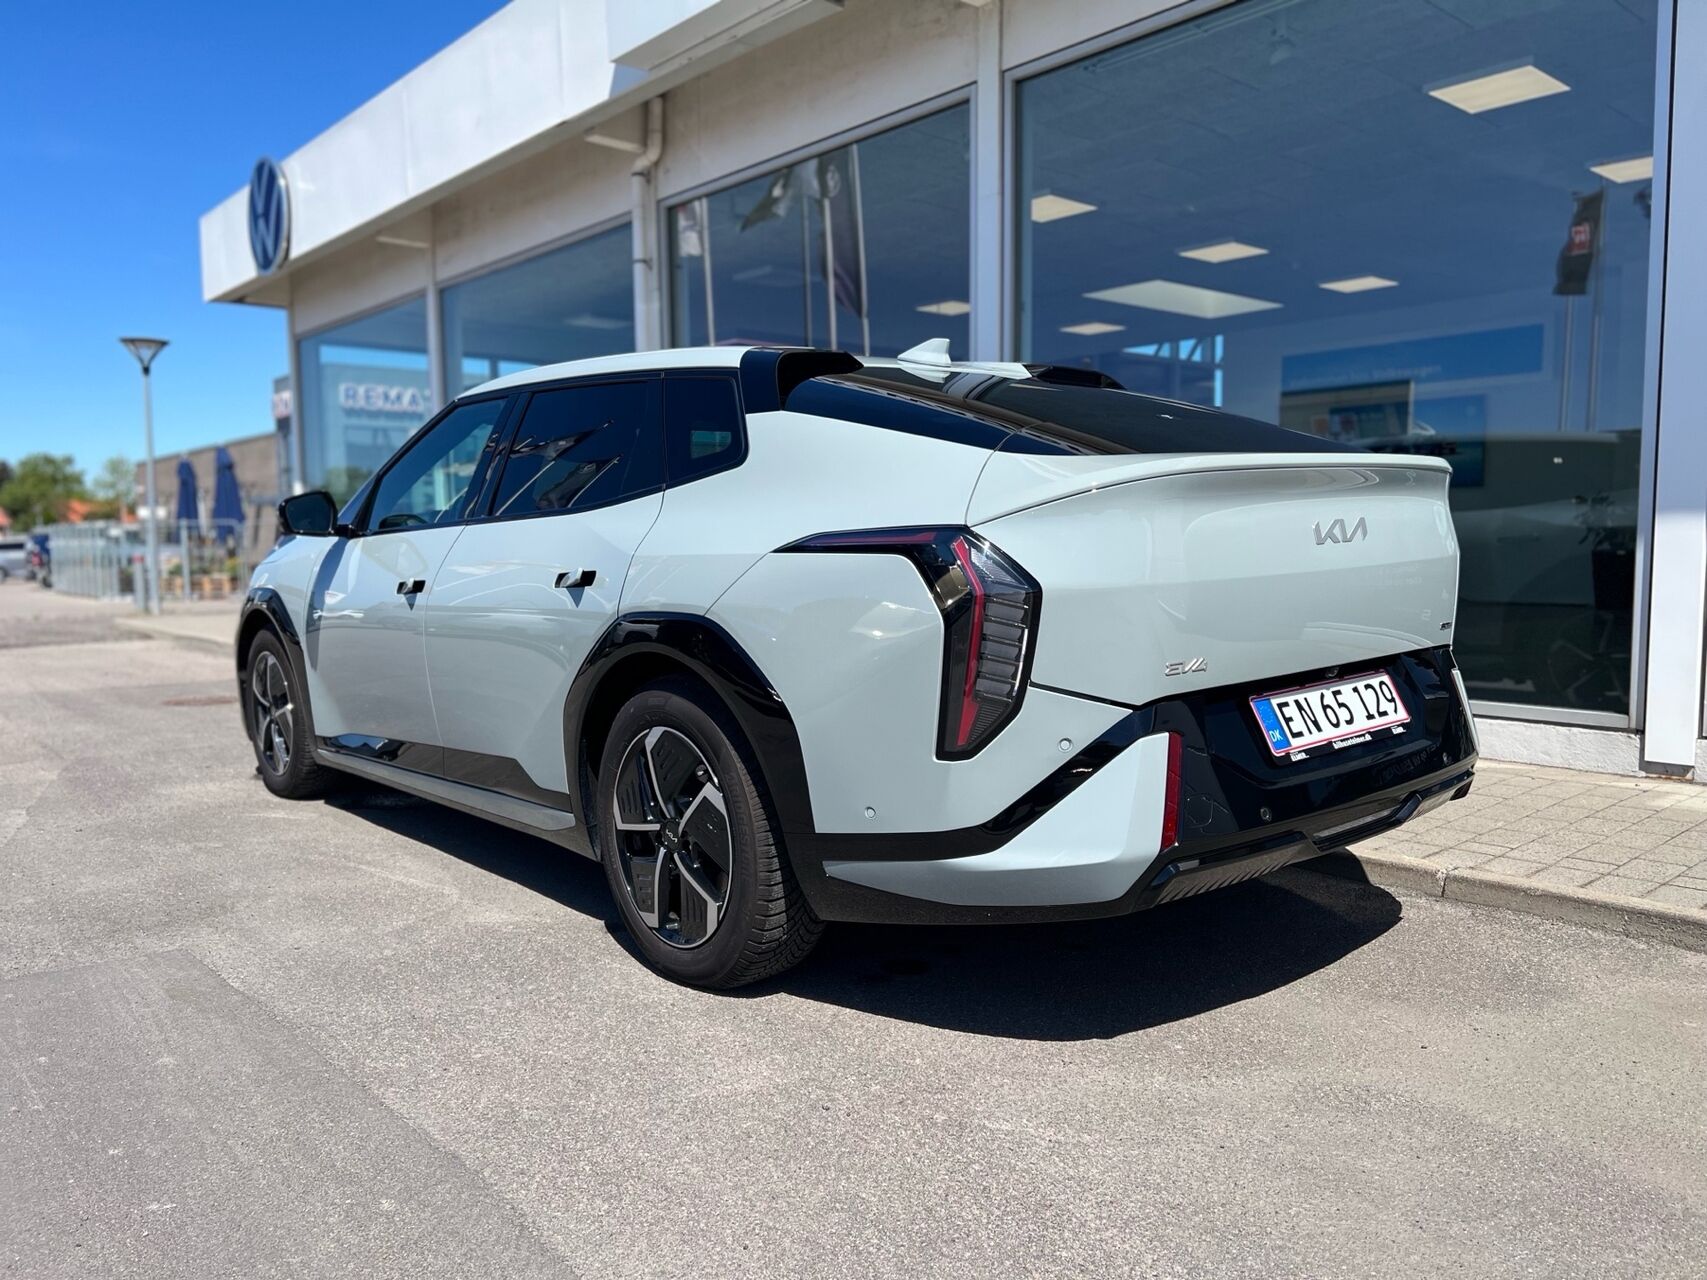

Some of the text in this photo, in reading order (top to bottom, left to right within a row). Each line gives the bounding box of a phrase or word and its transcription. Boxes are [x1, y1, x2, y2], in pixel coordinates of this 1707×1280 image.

[340, 383, 424, 412] REMA
[1313, 517, 1368, 545] KIA
[1165, 657, 1207, 677] EV4
[1276, 680, 1398, 739] EN 65 129
[1269, 730, 1283, 742] DK
